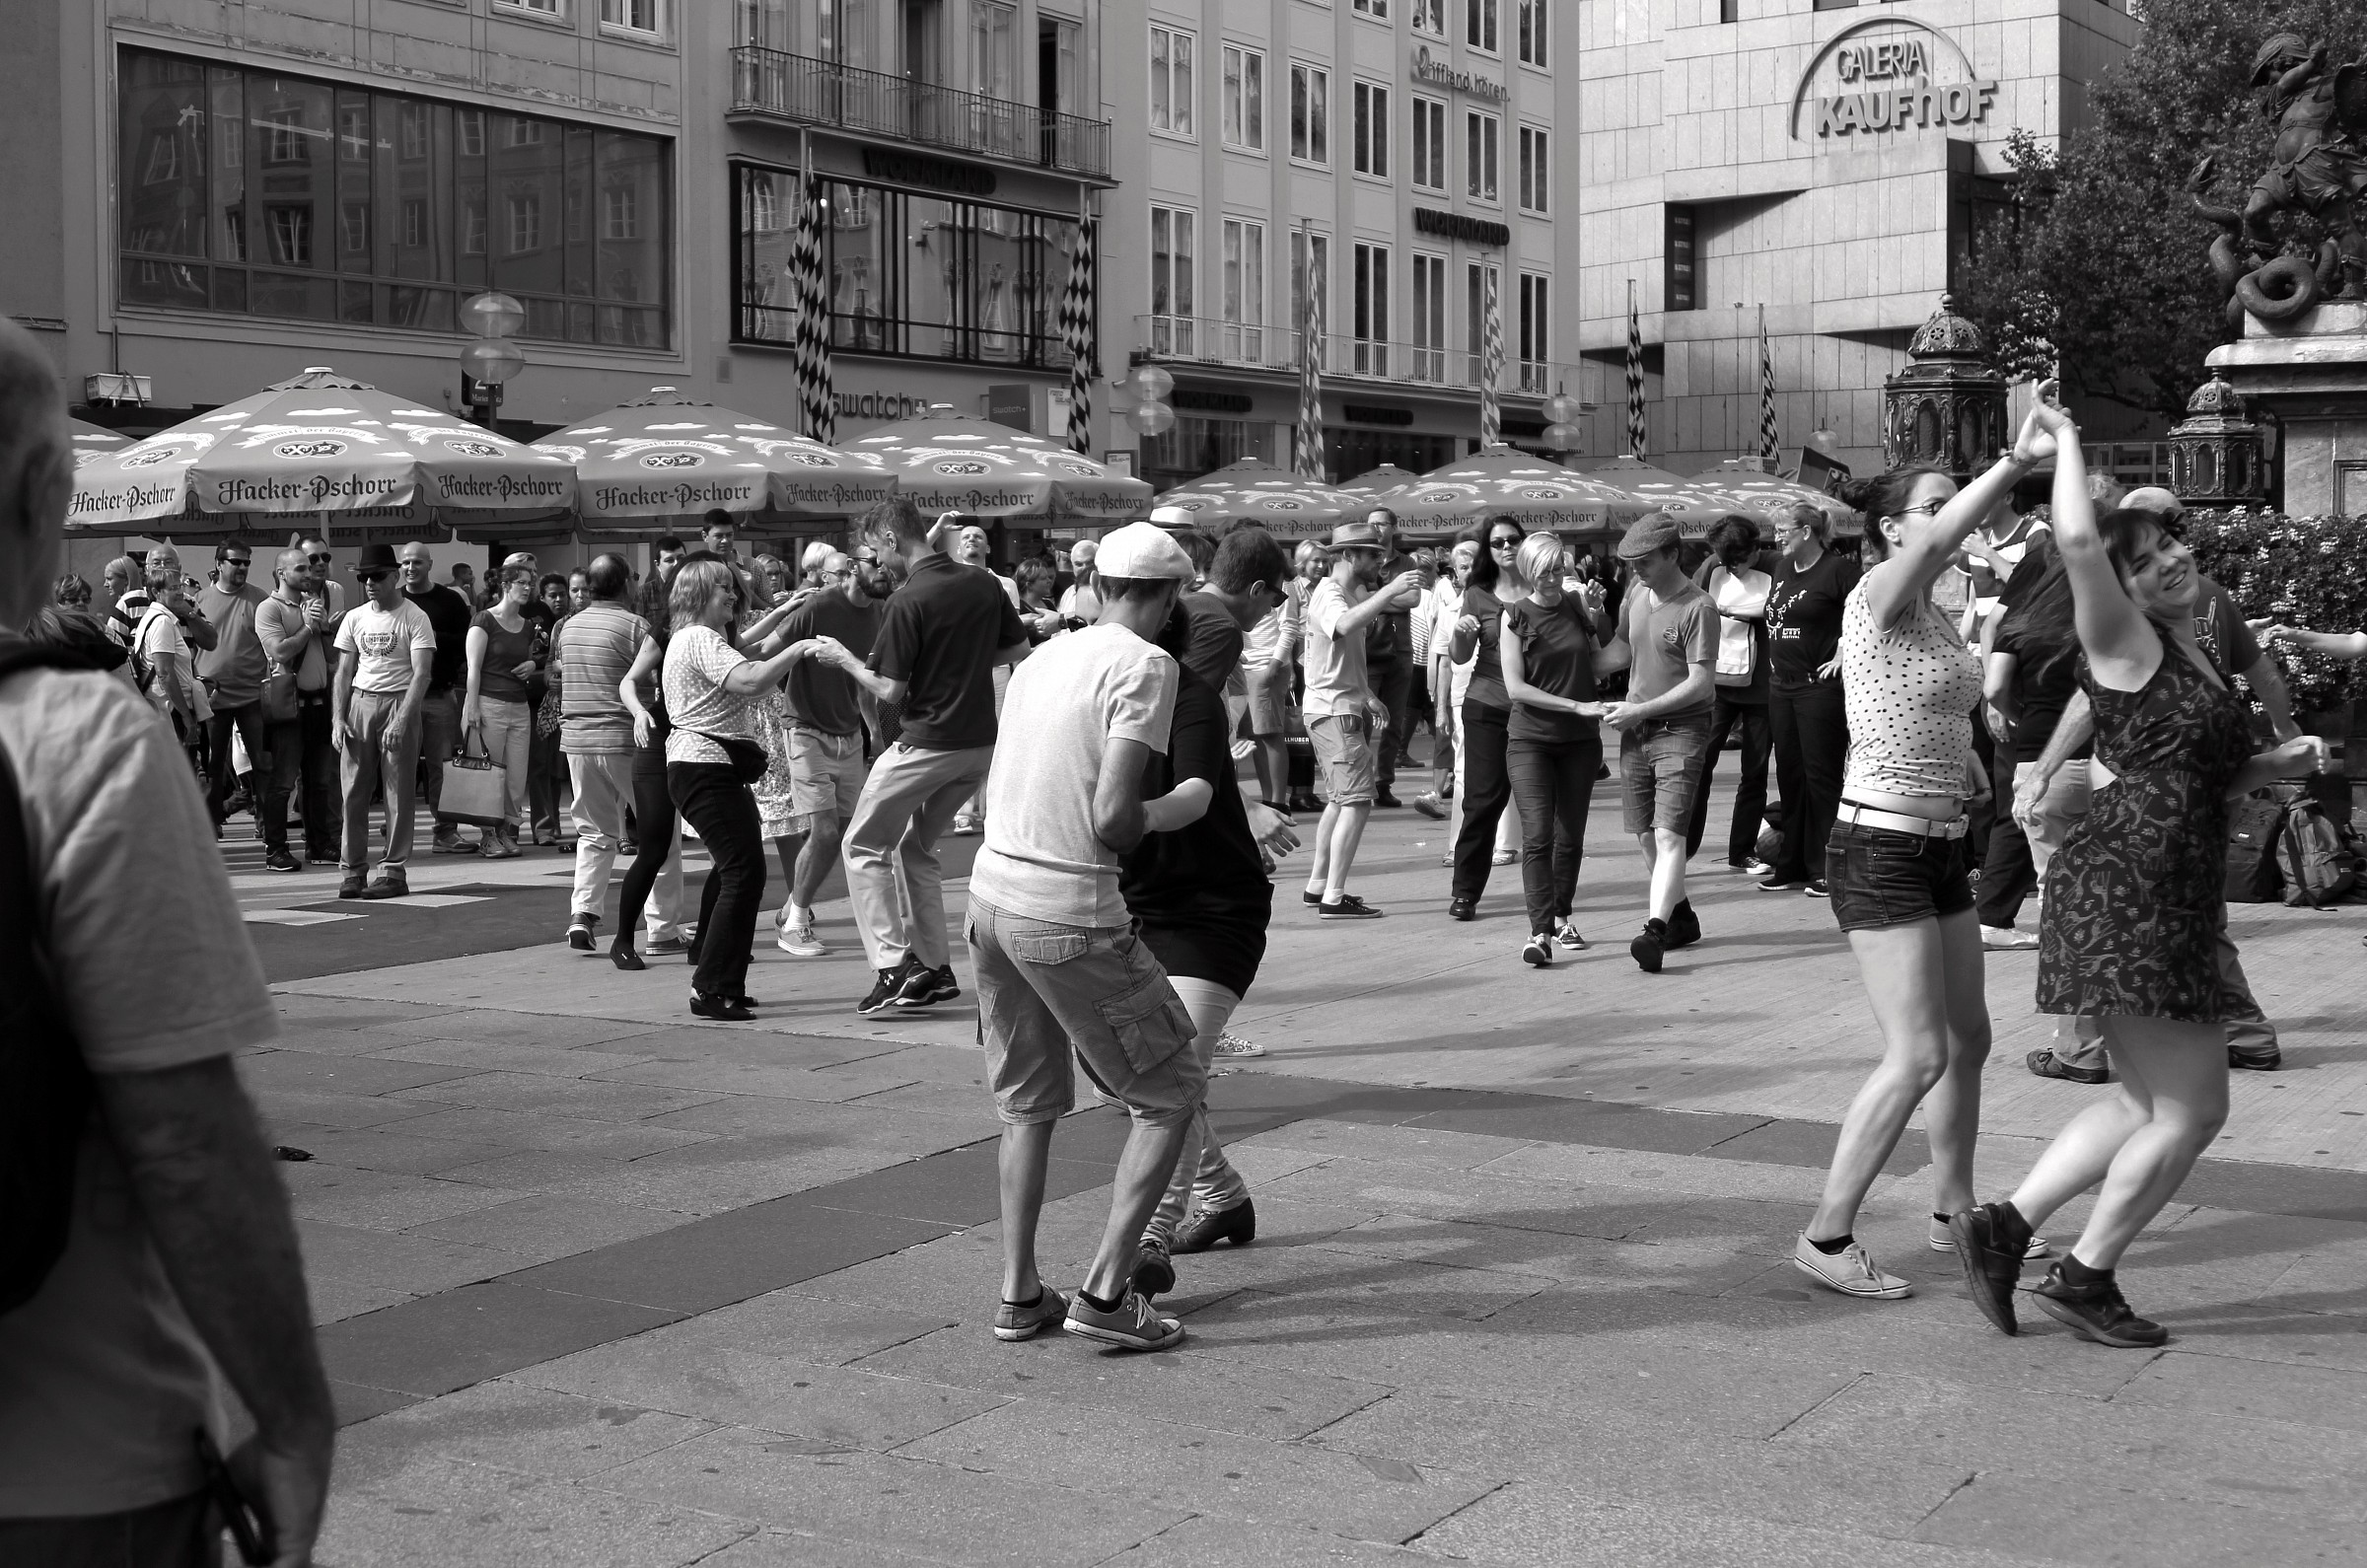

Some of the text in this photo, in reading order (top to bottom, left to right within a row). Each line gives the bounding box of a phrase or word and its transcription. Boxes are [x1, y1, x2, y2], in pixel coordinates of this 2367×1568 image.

[1836, 39, 1927, 80] GALERIA
[831, 390, 912, 420] swatch
[67, 482, 176, 517] Hacker-Pschorr
[218, 472, 396, 505] Hacker-Pschorr
[438, 473, 563, 502] Hacker-Pschorr
[596, 481, 752, 511] Hacker-Pschorr
[786, 482, 887, 508] Hacker-Pschorr
[1065, 491, 1145, 514] Hacker-Pschorr
[1265, 519, 1334, 535] ker-Pschorr
[1397, 513, 1474, 531] acker-Pschorr
